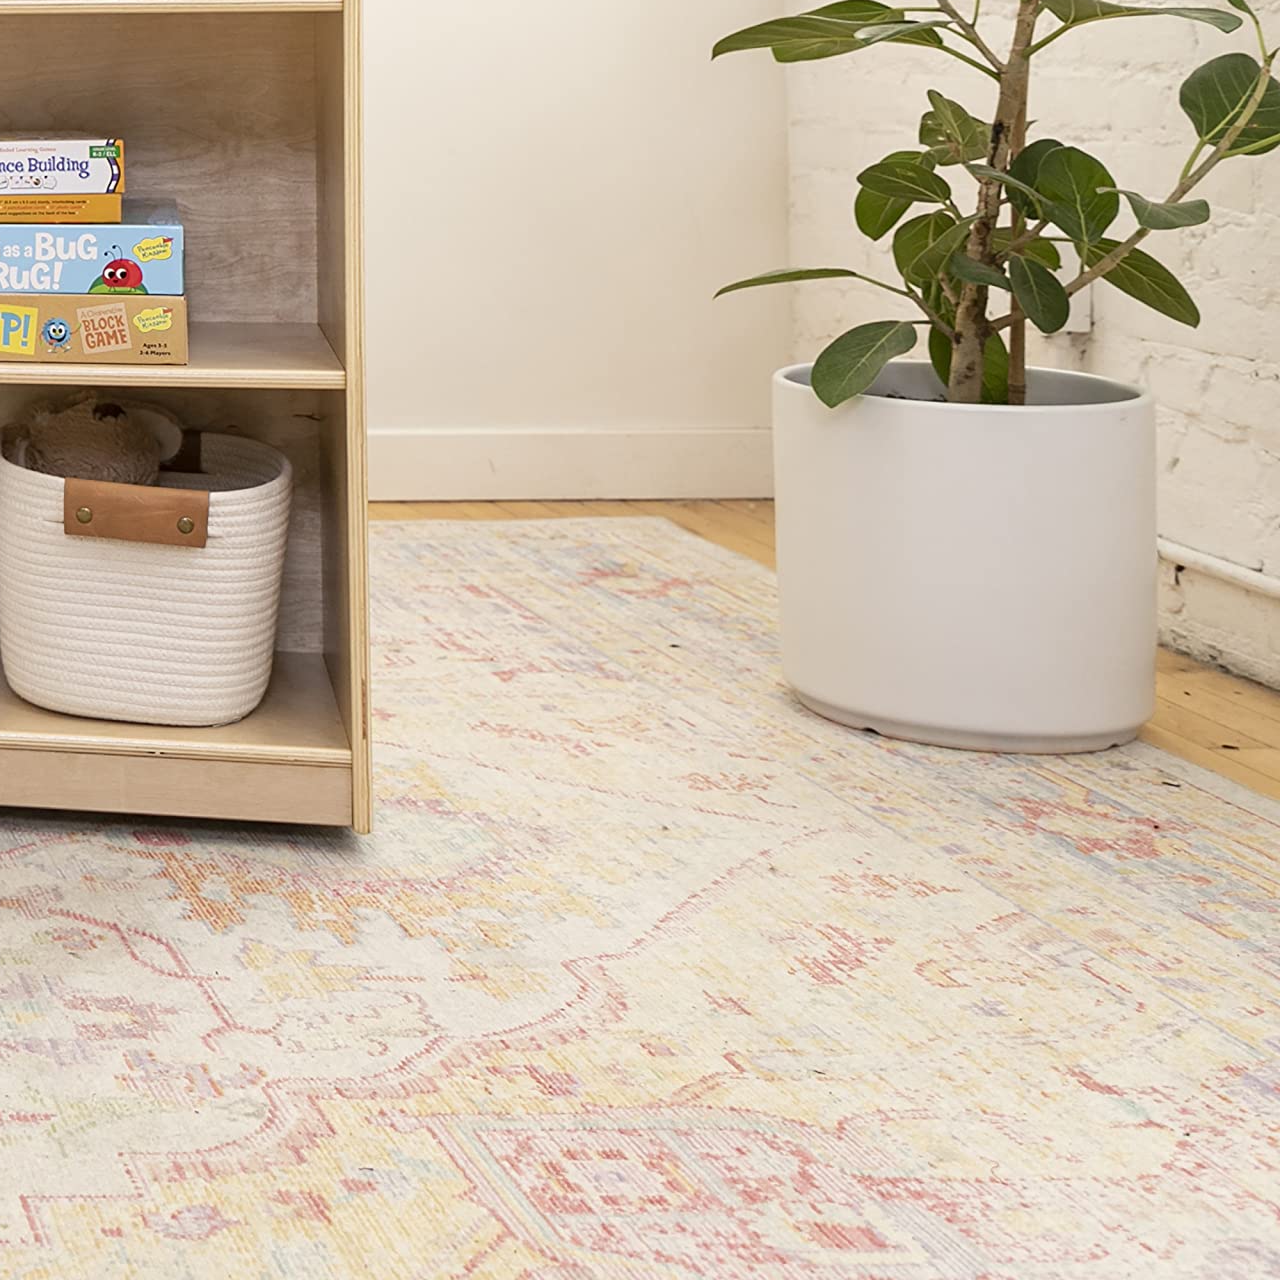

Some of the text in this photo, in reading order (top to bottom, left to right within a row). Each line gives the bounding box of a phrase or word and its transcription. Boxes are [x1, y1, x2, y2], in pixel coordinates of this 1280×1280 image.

[27, 156, 90, 179] Building
[3, 245, 20, 258] as
[24, 246, 32, 258] a
[82, 315, 125, 332] BLOCK
[85, 329, 127, 349] GAME
